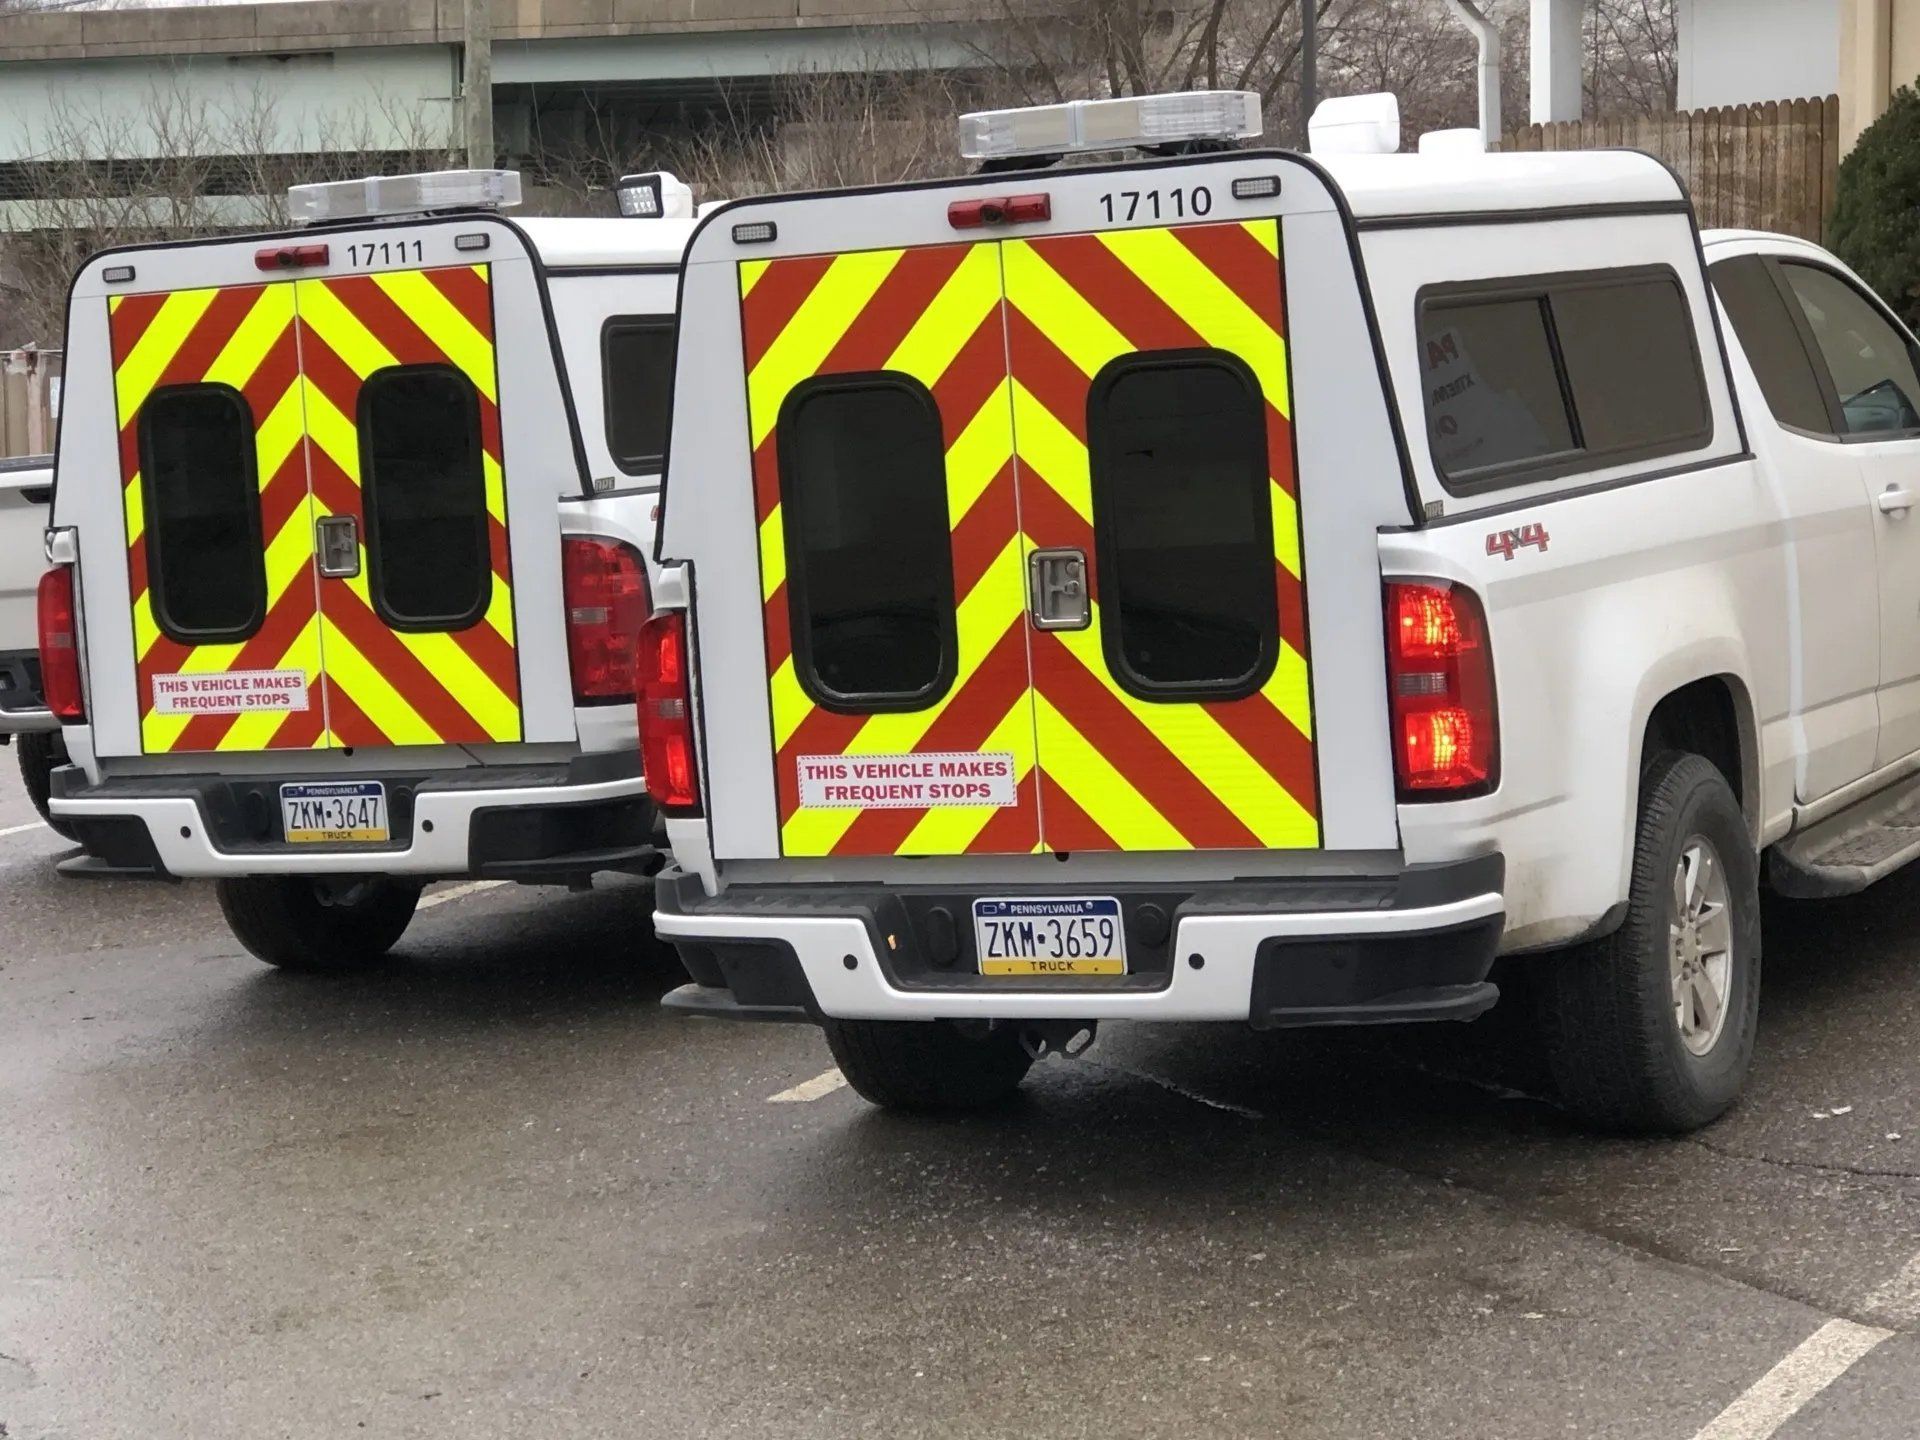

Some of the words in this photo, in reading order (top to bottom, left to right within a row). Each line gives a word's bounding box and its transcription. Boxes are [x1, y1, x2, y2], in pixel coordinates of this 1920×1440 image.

[1100, 186, 1212, 222] 17110
[347, 239, 423, 267] 17111
[158, 681, 189, 693] THIS
[192, 678, 249, 691] VEHICLE
[252, 676, 301, 690] MAKES
[172, 695, 243, 709] FREQUENT
[245, 693, 290, 706] STOPS
[805, 764, 848, 780] THIS
[852, 762, 934, 780] VEHICLE
[939, 761, 1008, 778] MAKES
[306, 787, 359, 795] PENNSYLVANIA
[824, 784, 924, 802] FREQUENT
[928, 783, 992, 799] STOPS
[320, 831, 353, 840] TRUCK
[1010, 903, 1084, 914] PENNSYLVANIA
[1030, 961, 1075, 972] TRUCK
